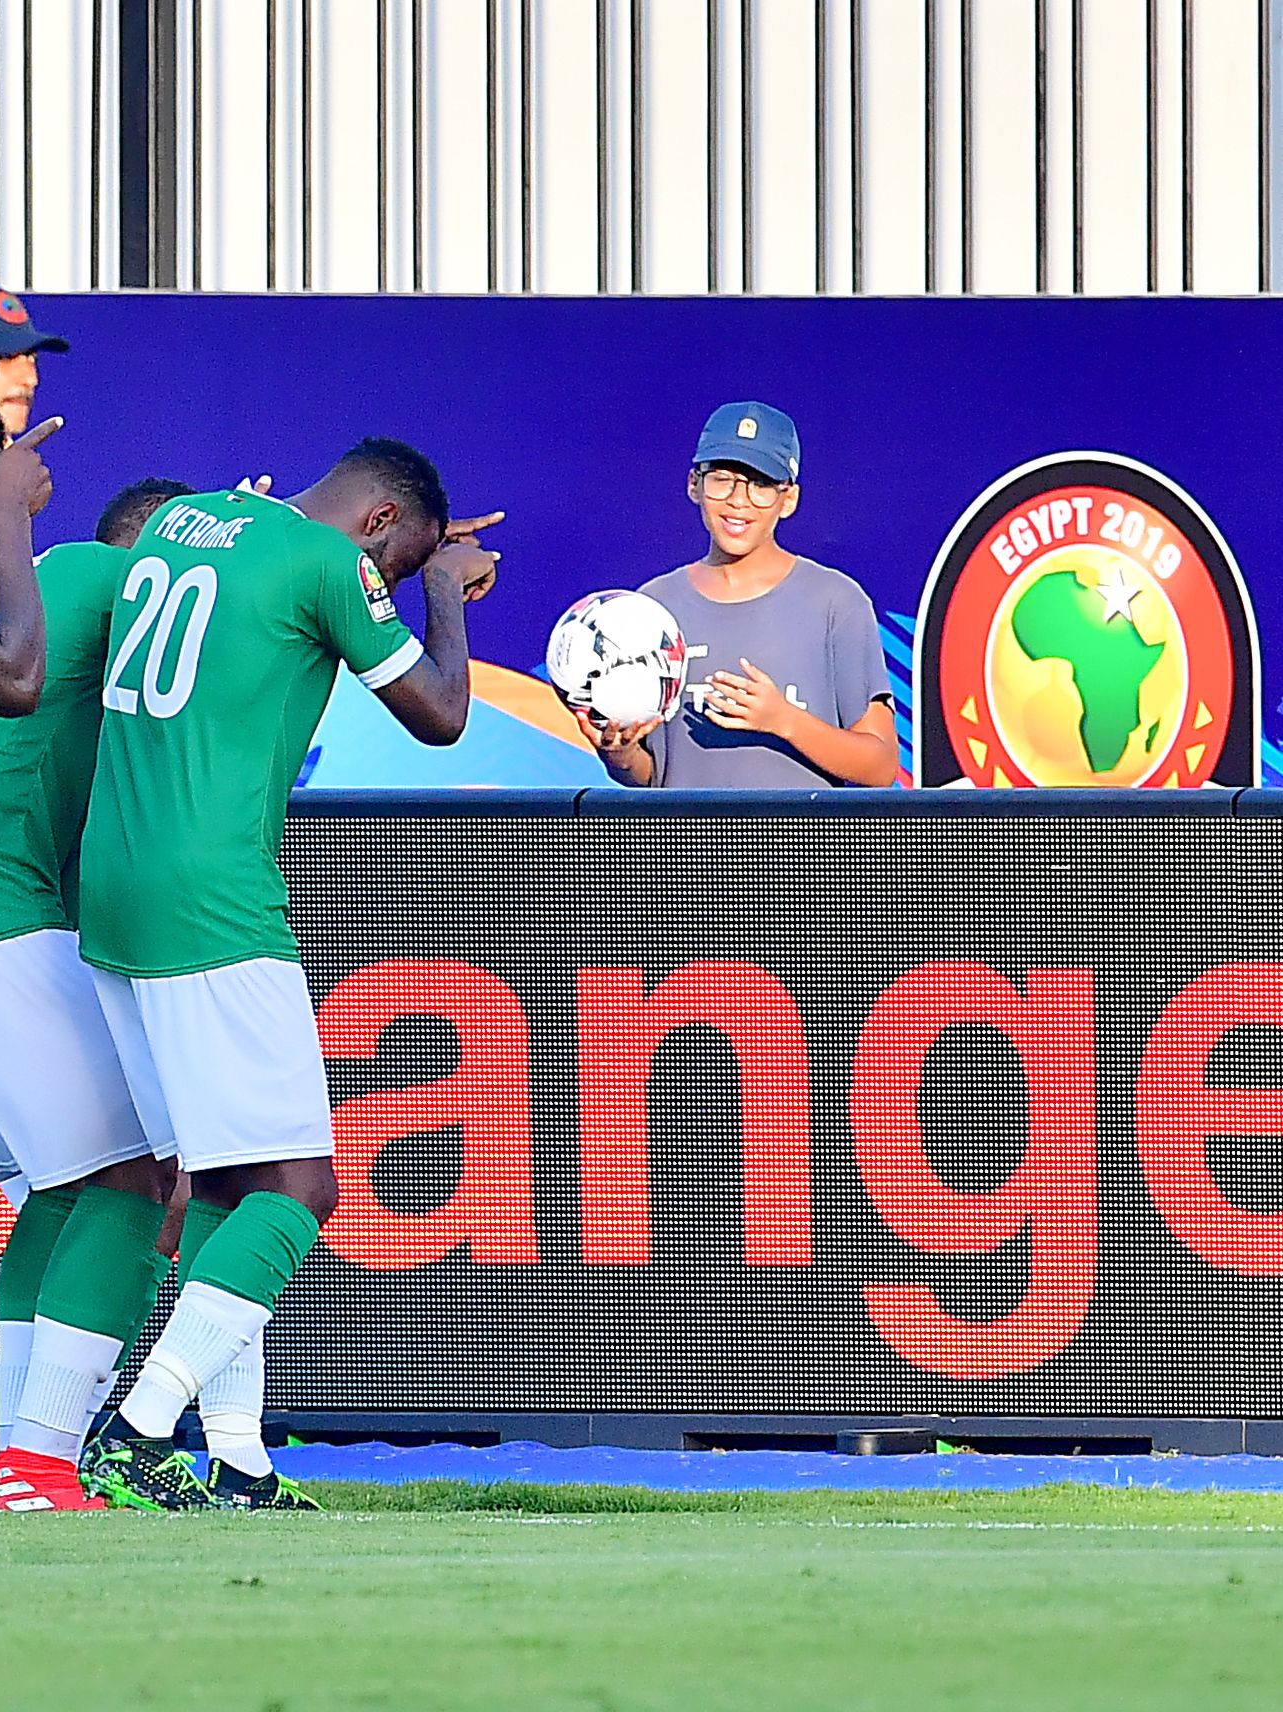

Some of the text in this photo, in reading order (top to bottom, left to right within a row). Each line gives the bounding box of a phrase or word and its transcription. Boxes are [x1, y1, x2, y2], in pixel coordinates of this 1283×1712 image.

[990, 496, 1183, 580] EGYPT 2019
[102, 555, 218, 719] 20
